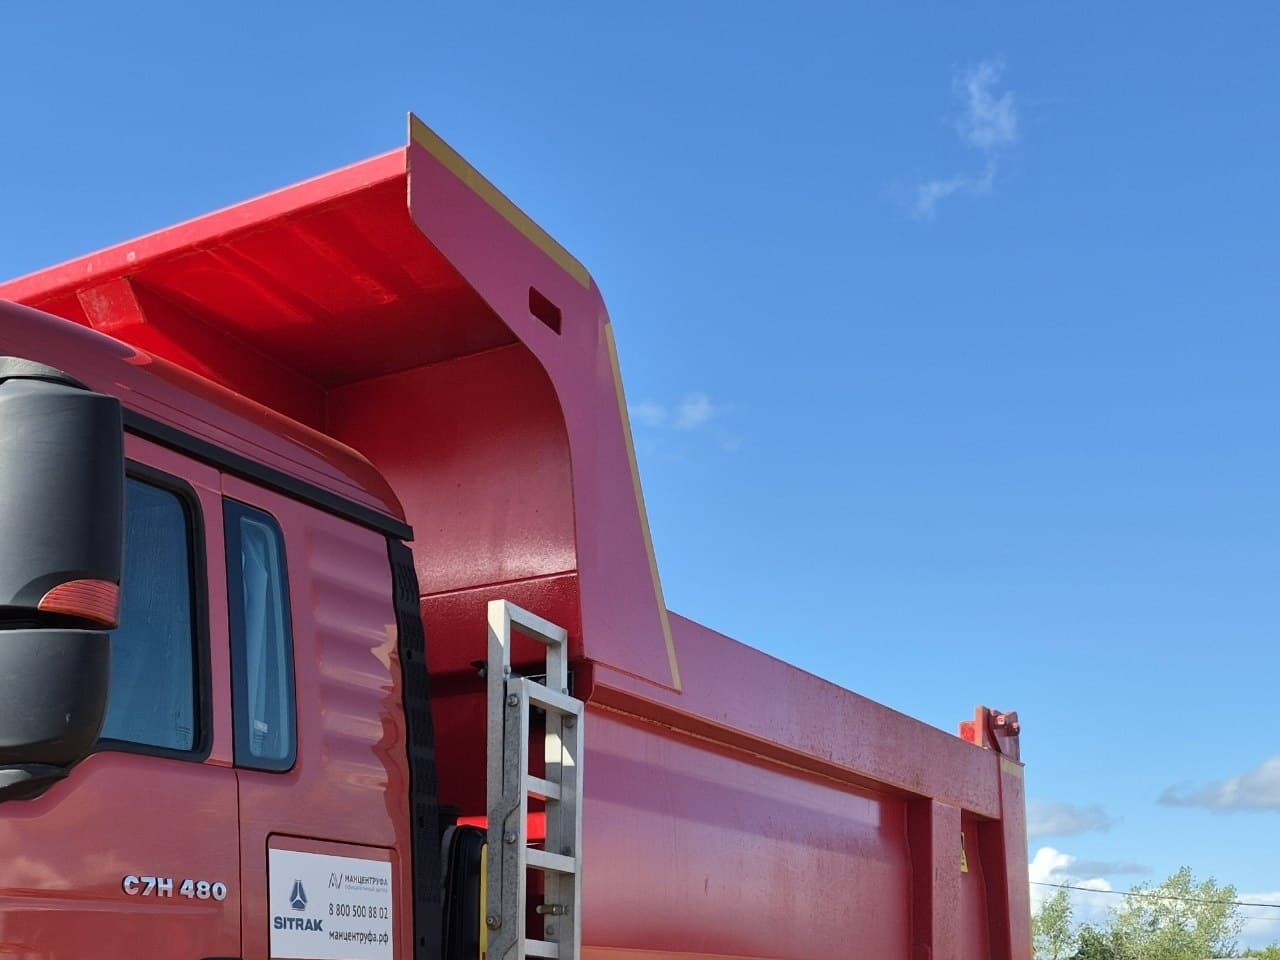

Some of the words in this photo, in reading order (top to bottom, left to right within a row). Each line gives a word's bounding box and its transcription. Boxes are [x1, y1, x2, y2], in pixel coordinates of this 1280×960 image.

[122, 875, 173, 898] C7H
[180, 879, 227, 901] 480
[328, 903, 334, 916] 8
[336, 903, 350, 917] 800
[352, 905, 366, 918] 500
[379, 907, 388, 920] 02
[273, 916, 323, 932] SITRAK
[328, 930, 389, 945] манцентруфа.рф
